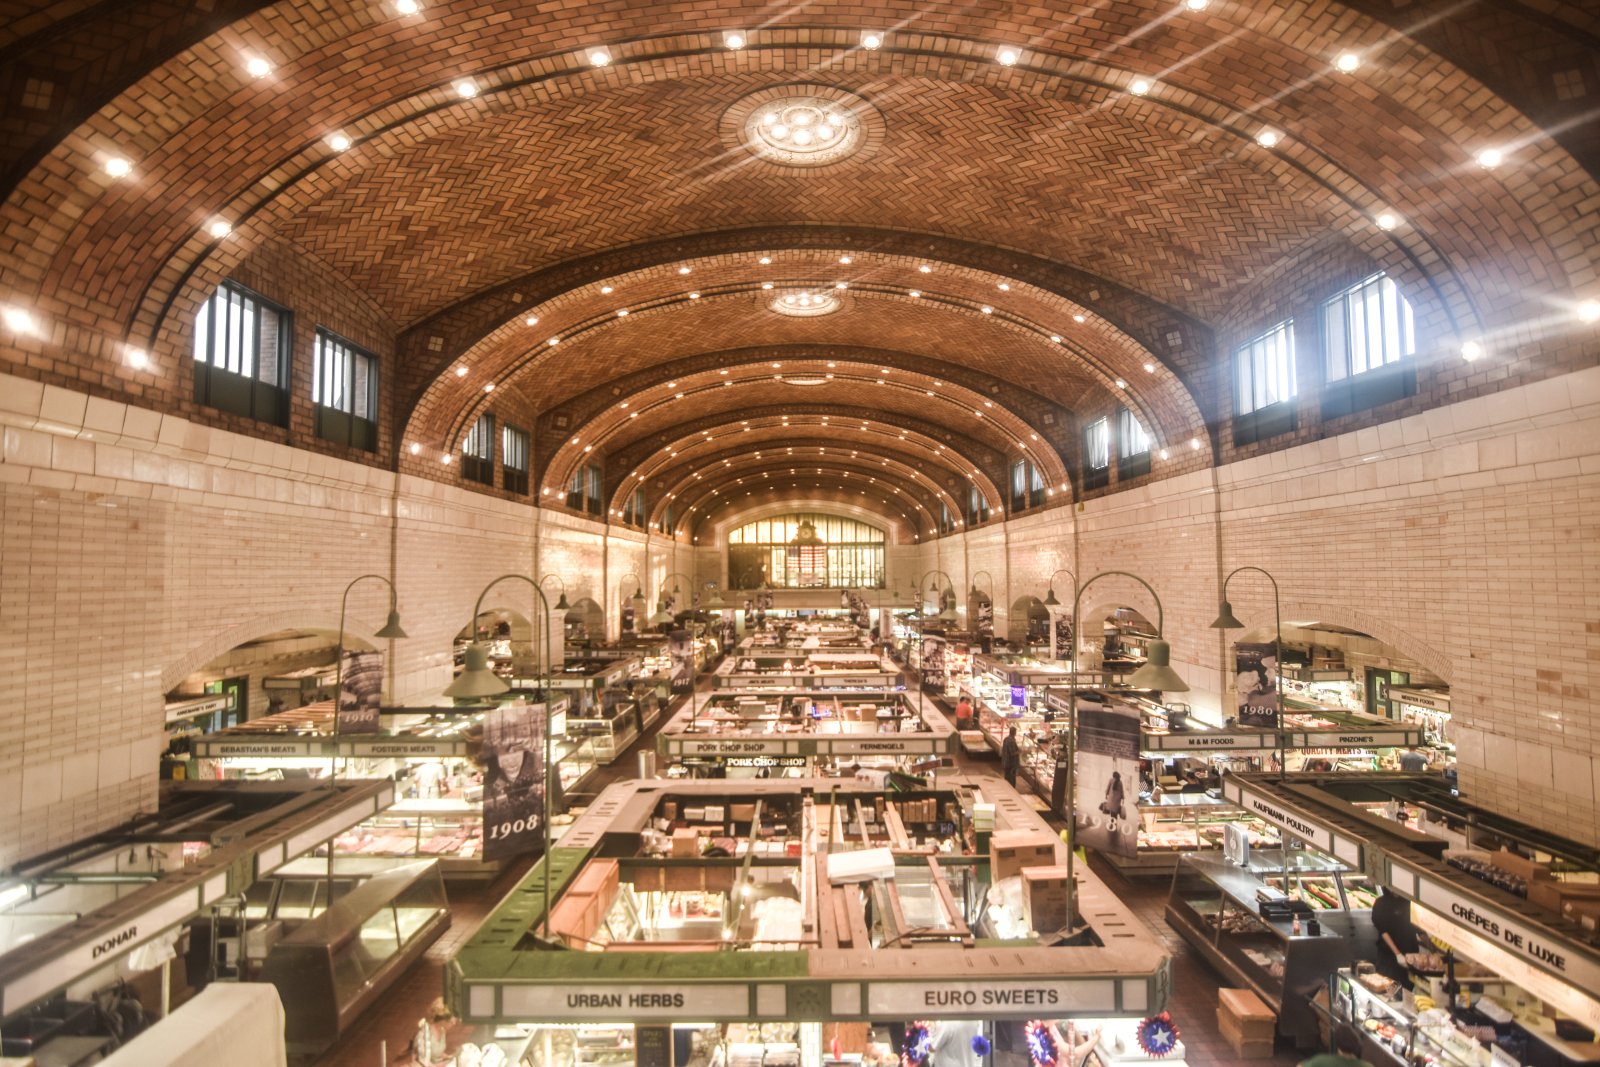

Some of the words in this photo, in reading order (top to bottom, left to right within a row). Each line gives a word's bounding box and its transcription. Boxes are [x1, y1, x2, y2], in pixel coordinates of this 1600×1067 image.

[1242, 705, 1274, 716] 1980
[220, 745, 269, 754] SEBASTIAN'S
[270, 745, 297, 753] MEATS
[371, 745, 409, 753] FOSTER'S
[410, 745, 436, 753] MEATS
[697, 743, 718, 752] PORK
[719, 743, 741, 752] CHOP
[743, 743, 766, 752] SHOP
[726, 757, 752, 767] PORK
[752, 757, 780, 767] CHOP
[780, 757, 806, 767] SHOP
[1079, 812, 1134, 837] 1980
[1253, 799, 1285, 822] KAUFMANN
[1286, 816, 1315, 838] POULTRY
[489, 814, 539, 840] 1908
[92, 926, 137, 959] DOHAR
[1451, 902, 1500, 937] CRÊPES
[1504, 928, 1524, 950] DE
[1528, 941, 1566, 972] LUXE
[567, 993, 622, 1008] URBAN
[628, 993, 685, 1008] HERBS
[924, 990, 977, 1006] EURO
[982, 988, 1059, 1005] SWEETS
